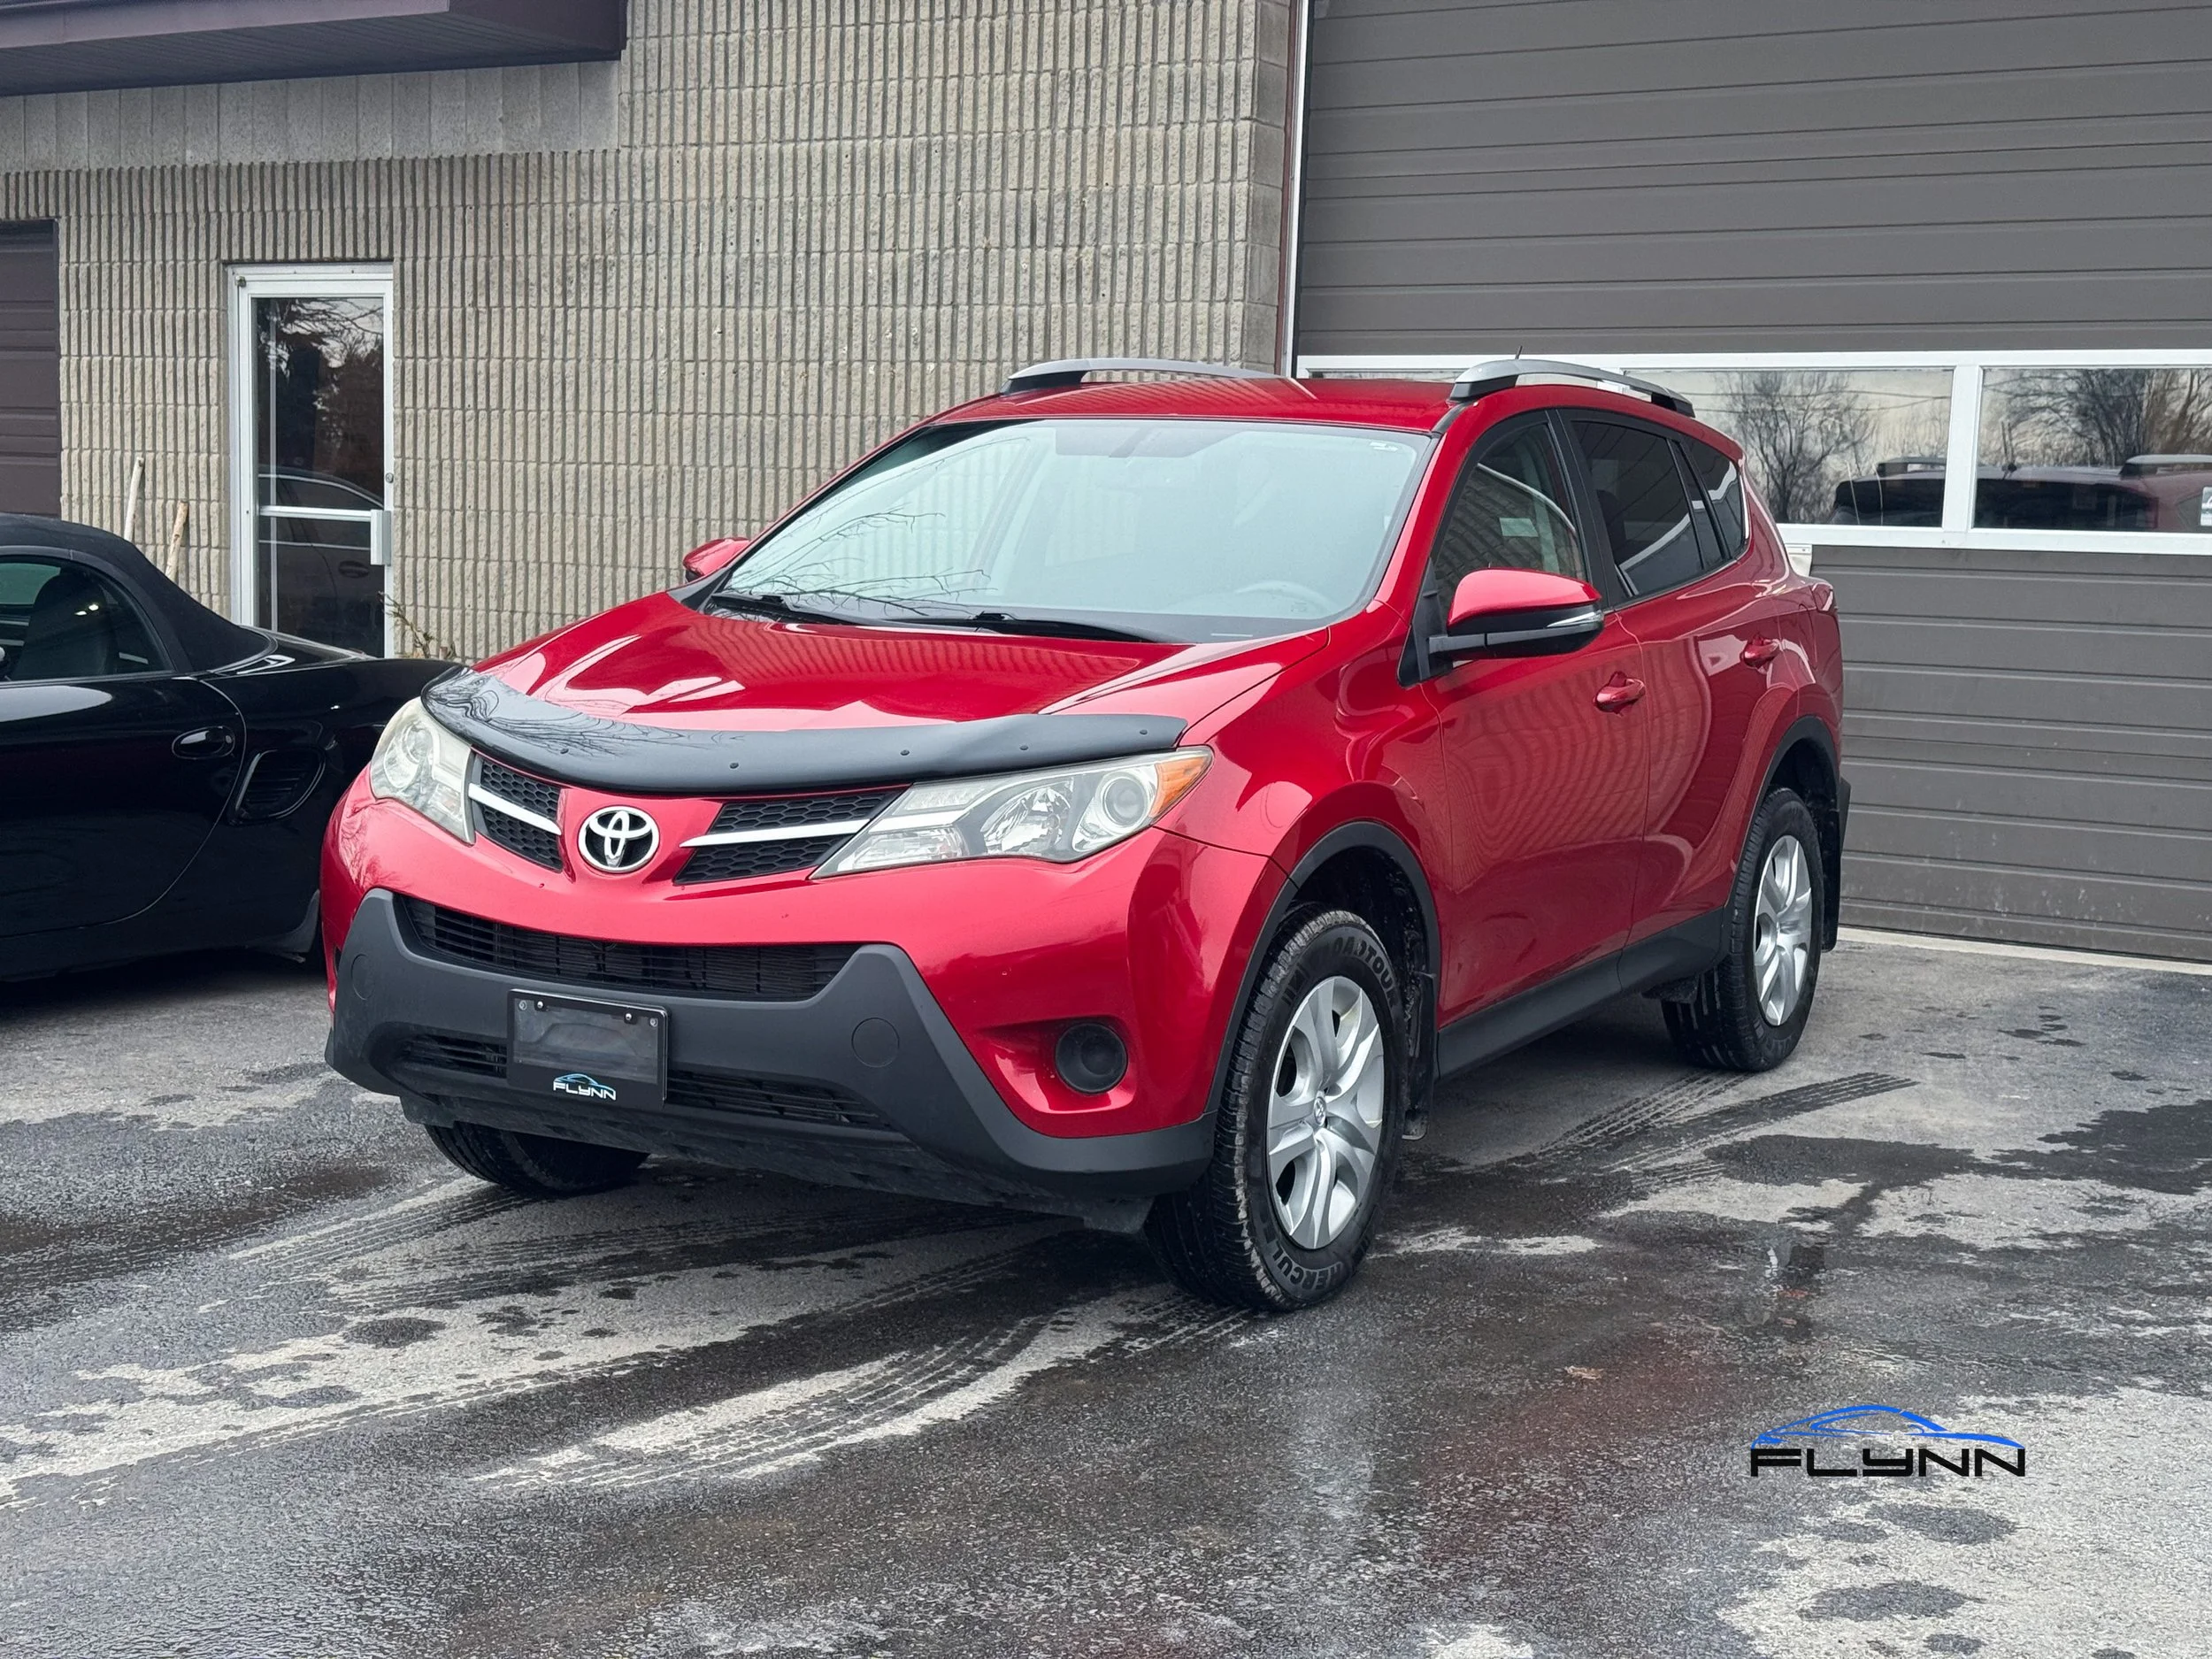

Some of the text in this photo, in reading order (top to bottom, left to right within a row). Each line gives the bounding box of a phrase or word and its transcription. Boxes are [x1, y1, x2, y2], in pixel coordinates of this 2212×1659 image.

[1325, 936, 1398, 1007] OADTOUR
[553, 1082, 616, 1101] FLYNN
[1260, 1210, 1341, 1290] HERCUL
